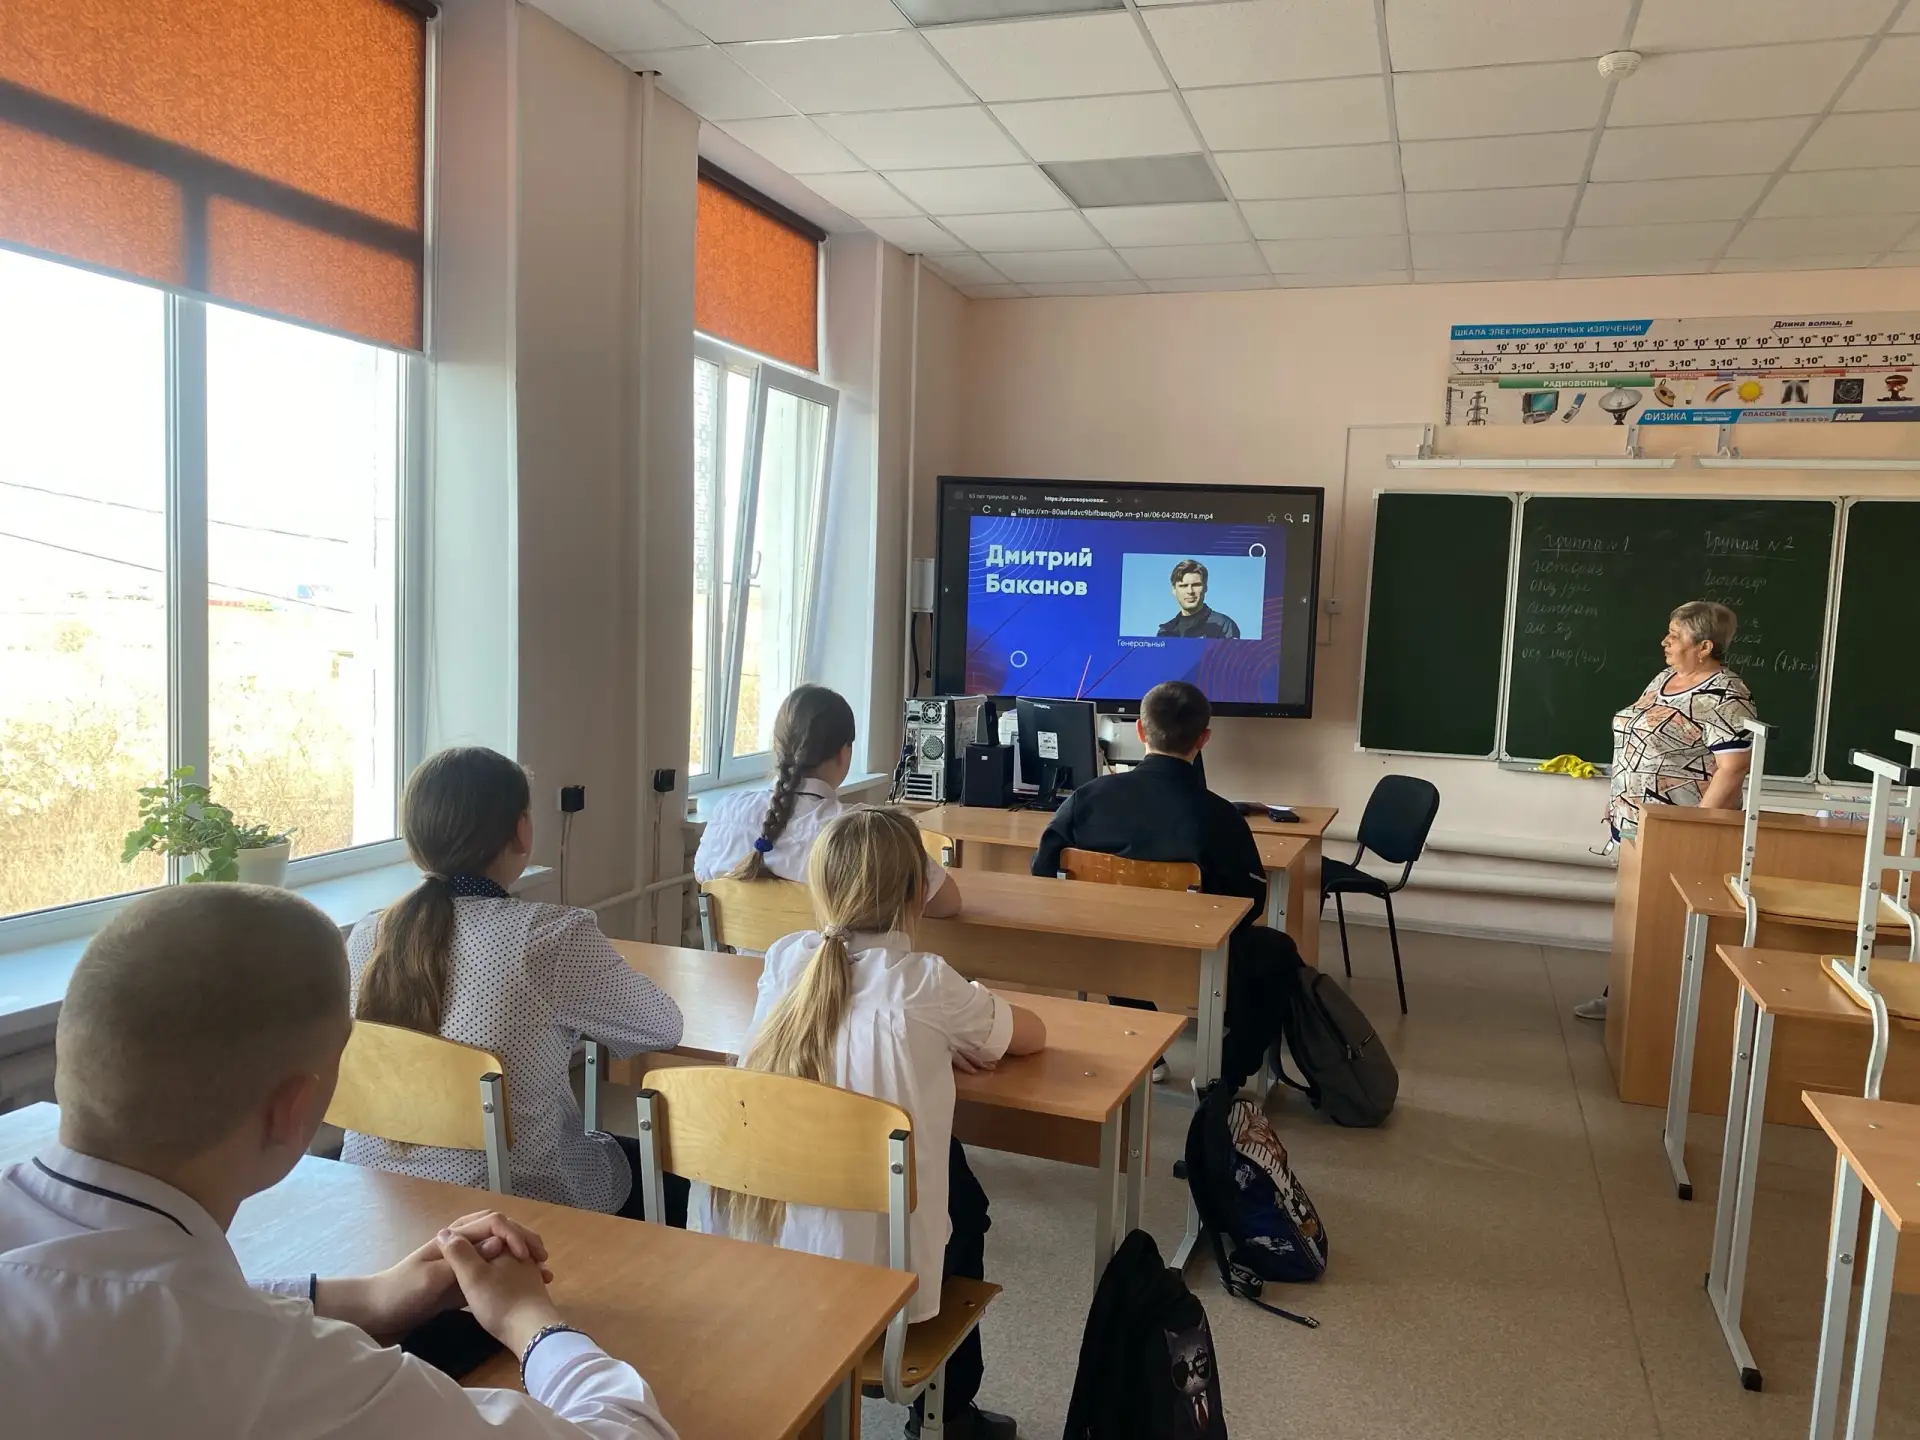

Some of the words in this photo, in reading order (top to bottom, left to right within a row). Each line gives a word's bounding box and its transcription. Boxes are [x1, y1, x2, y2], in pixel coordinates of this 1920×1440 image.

[1808, 320, 1843, 328] волны,
[1455, 328, 1486, 337] ШКАЛА
[1489, 326, 1585, 336] ЭЛЕКТРОМАГНИТНЫХ
[1543, 379, 1608, 388] РАДИОВОЛНЫ
[1644, 412, 1687, 422] ФИЗИКА
[1742, 410, 1788, 418] КЛАССНОЕ
[986, 544, 1092, 571] Дмитрий
[986, 573, 1088, 596] Баканов
[1117, 639, 1166, 649] Генеральный
